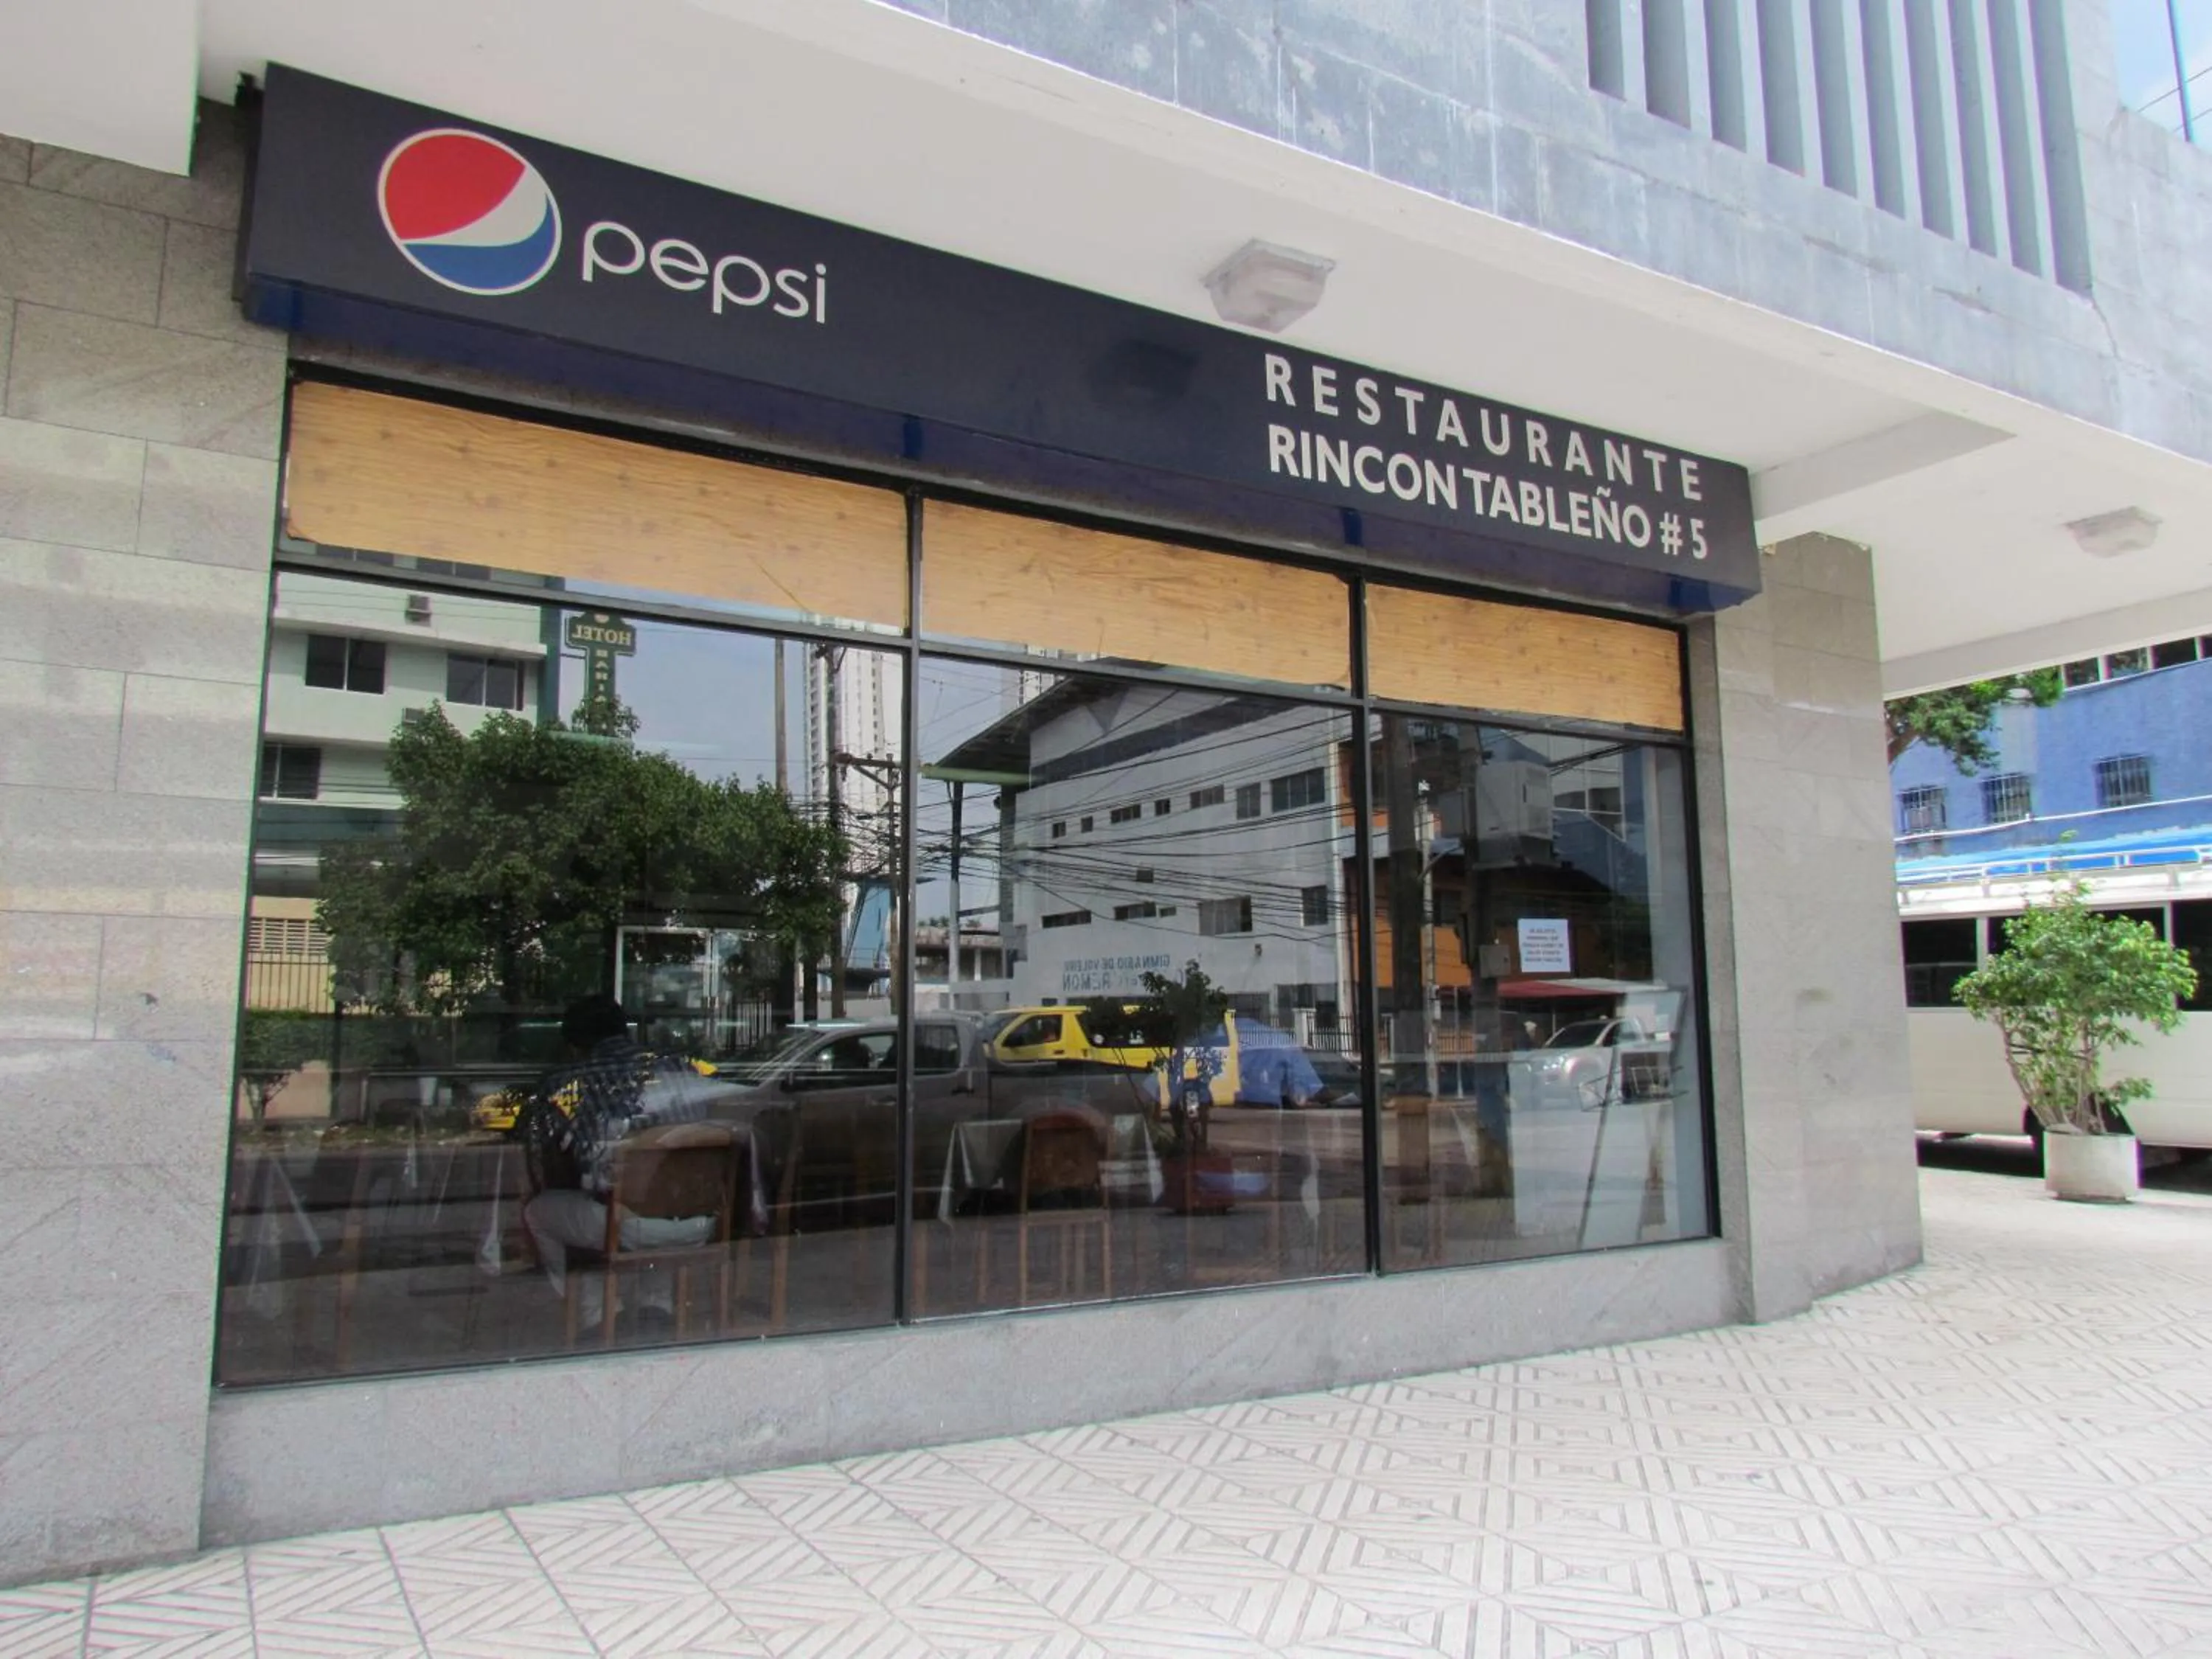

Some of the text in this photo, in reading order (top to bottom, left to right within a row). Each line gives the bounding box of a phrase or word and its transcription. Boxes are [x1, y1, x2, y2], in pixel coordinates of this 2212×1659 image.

[582, 220, 827, 324] pepsi
[1265, 353, 1703, 502] RESTAURANTE
[1268, 423, 1458, 511] RINCON
[1463, 467, 1652, 549] TABLEÑO
